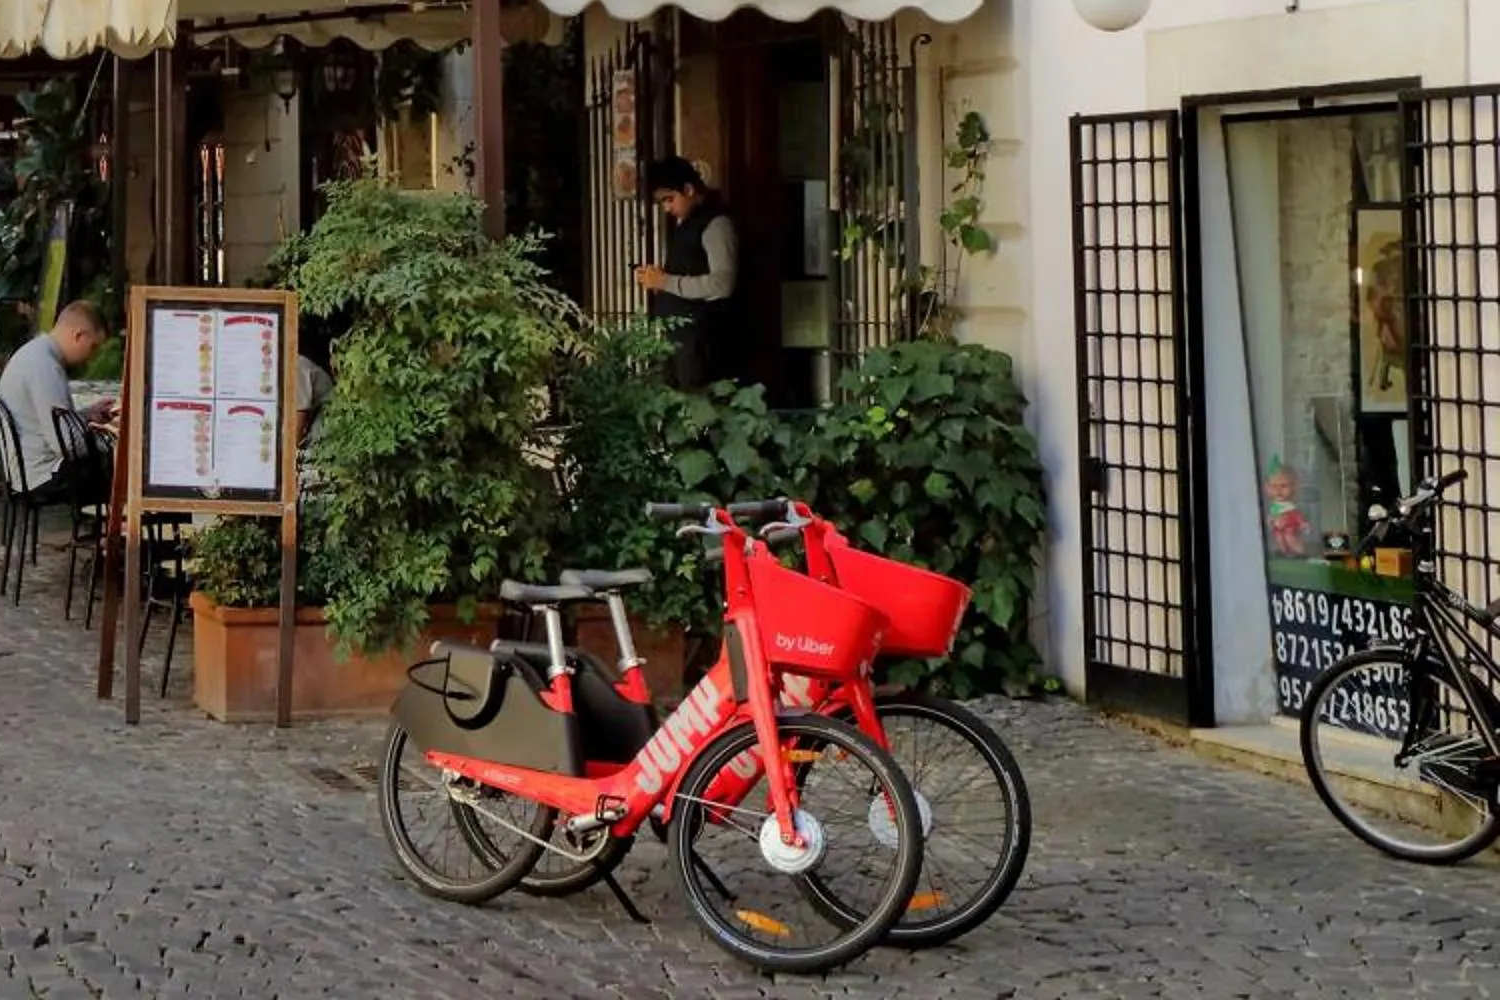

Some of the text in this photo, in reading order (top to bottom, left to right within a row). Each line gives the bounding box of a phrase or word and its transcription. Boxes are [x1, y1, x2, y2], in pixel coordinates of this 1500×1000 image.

[775, 631, 835, 656] by Uber
[635, 674, 721, 795] JUMP
